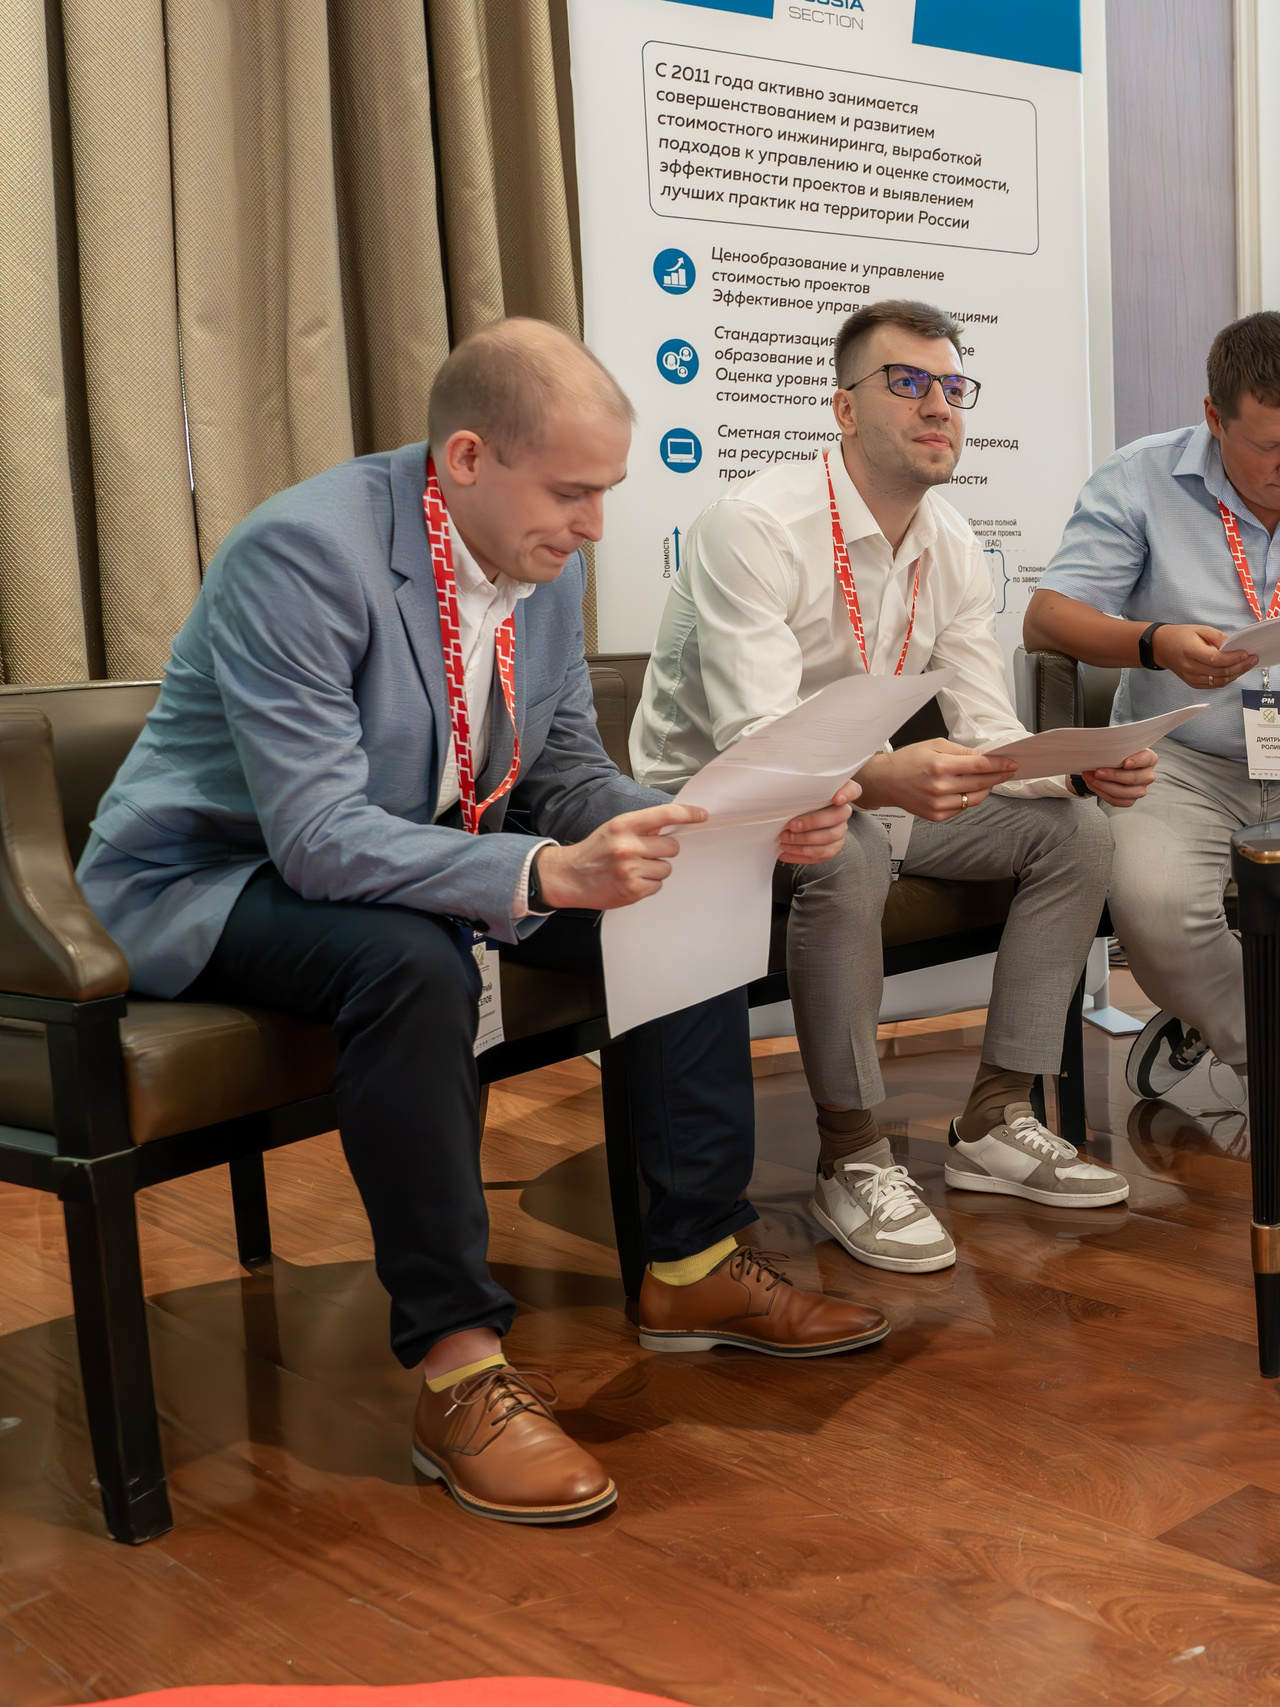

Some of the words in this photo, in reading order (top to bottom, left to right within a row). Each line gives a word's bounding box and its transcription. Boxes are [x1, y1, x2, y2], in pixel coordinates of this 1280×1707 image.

[788, 6, 864, 30] SECTION
[654, 61, 667, 78] С
[670, 64, 710, 84] 2011
[714, 74, 754, 91] года
[757, 80, 825, 101] активно
[827, 91, 918, 115] занимается
[655, 89, 836, 125] совершенствованием
[840, 115, 850, 127] и
[852, 117, 935, 139] развитием
[656, 113, 773, 139] стоимостного
[776, 129, 888, 157] инжиниринга,
[891, 144, 982, 167] выработкой
[658, 137, 741, 158] подходов
[744, 147, 754, 160] к
[757, 149, 859, 173] управлению
[862, 163, 872, 174] и
[875, 165, 929, 182] оценке
[931, 172, 1010, 194] стоимости,
[659, 158, 789, 186] эффективности
[792, 176, 866, 196] проектов
[869, 186, 879, 197] и
[882, 187, 974, 208] выявлением
[659, 184, 725, 202] лучших
[728, 192, 796, 210] практик
[799, 200, 820, 213] на
[823, 202, 914, 224] территории
[917, 209, 970, 229] России
[711, 246, 847, 272] Ценообразование
[850, 262, 859, 273] и
[861, 264, 945, 281] управление
[711, 271, 801, 288] стоимостью
[803, 278, 870, 294] проектов
[712, 288, 814, 310] Эффективное
[815, 300, 860, 315] управ
[713, 325, 836, 348] Стандартизация
[714, 346, 813, 366] образование
[815, 356, 825, 366] и
[714, 366, 773, 384] Оценка
[775, 374, 828, 388] уровня
[715, 390, 817, 406] стоимостного
[716, 423, 781, 440] Сметная
[784, 430, 842, 442] стоимос
[964, 437, 1019, 450] переход
[717, 448, 737, 458] на
[968, 518, 994, 526] Прогноз
[663, 537, 671, 578] Стоимость
